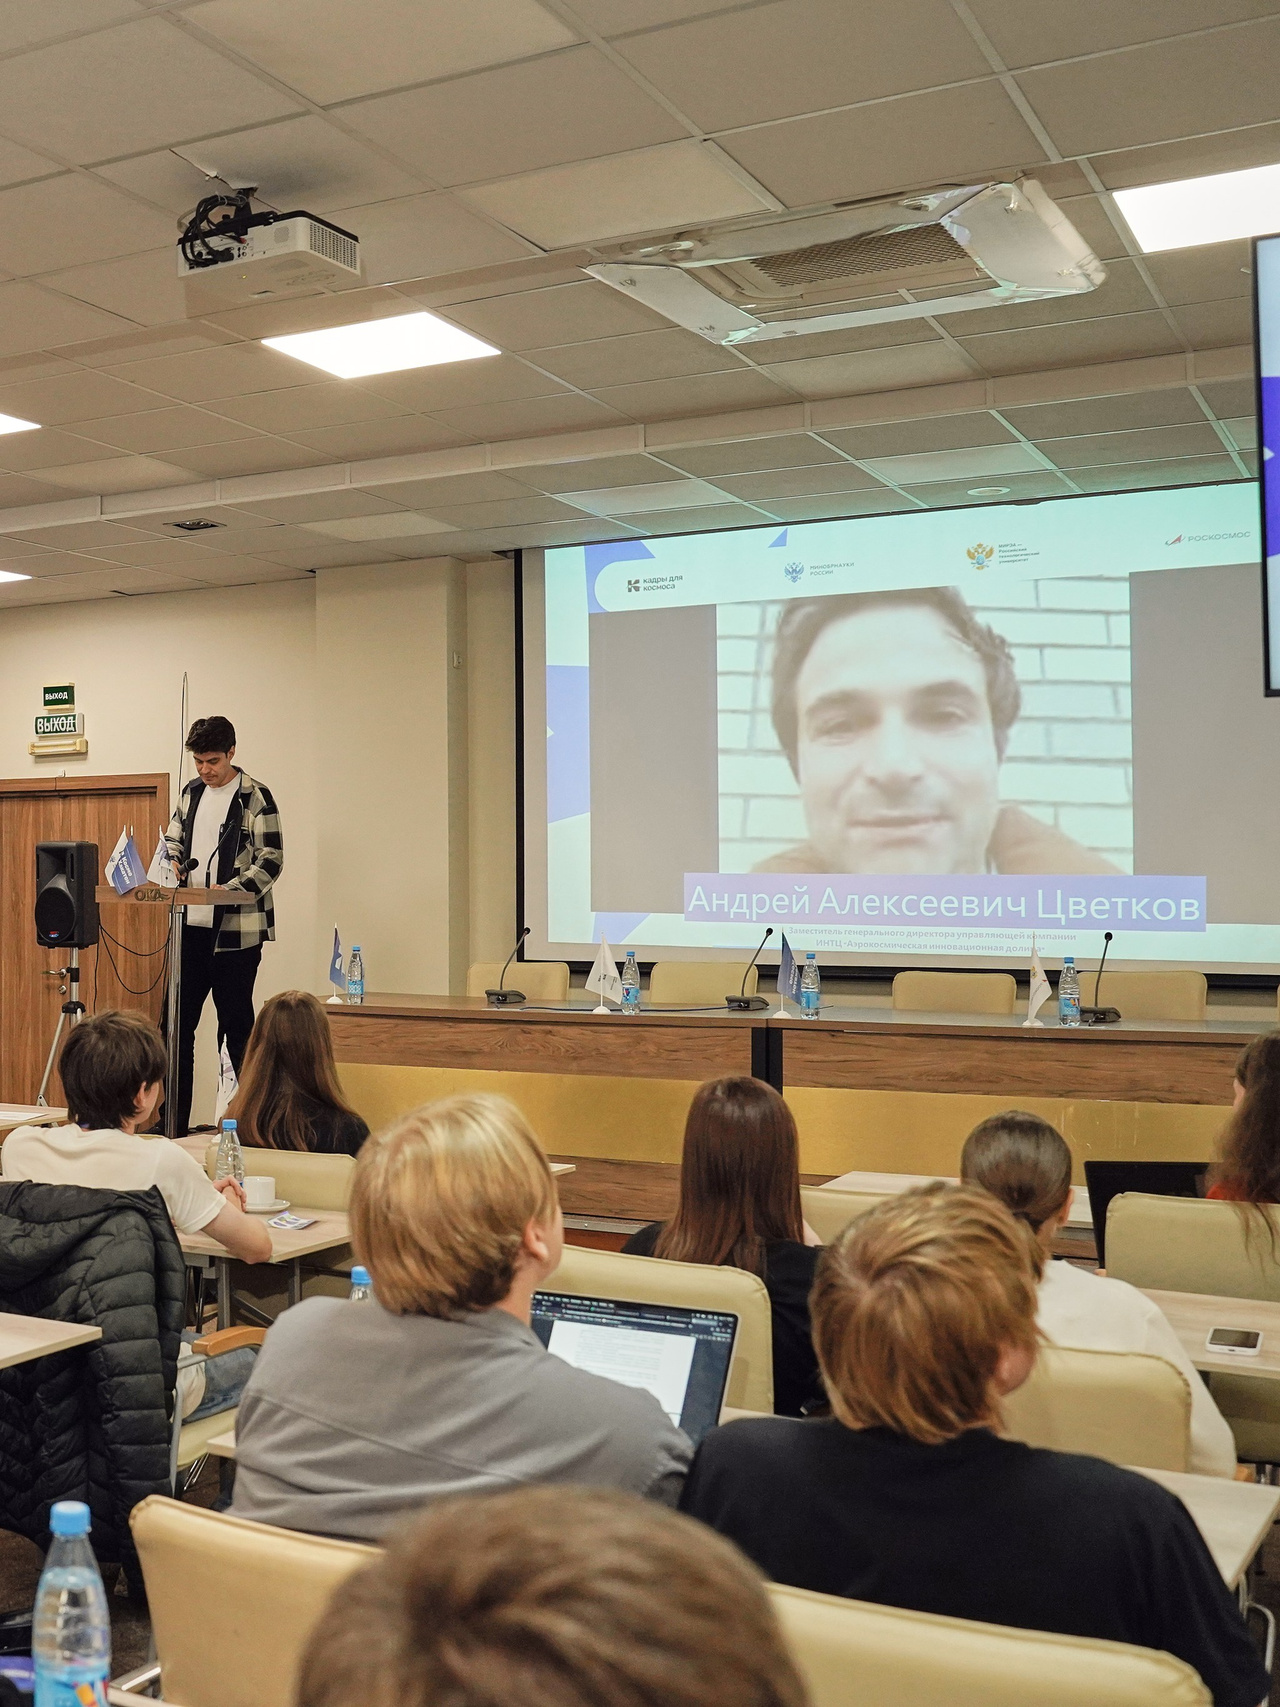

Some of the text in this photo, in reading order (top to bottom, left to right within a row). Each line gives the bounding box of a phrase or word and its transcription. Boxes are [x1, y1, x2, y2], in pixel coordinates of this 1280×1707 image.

[1188, 531, 1251, 542] РОСКОСМОС
[809, 562, 855, 570] МИНОБРНАУКИ
[809, 569, 834, 577] РОССИИ
[643, 575, 683, 584] кадры для
[643, 583, 676, 591] космоса
[45, 691, 68, 701] ВЫХОД
[37, 716, 75, 734] ВЫХОД
[687, 885, 1200, 925] Андрей Алексеевич Цветков
[788, 926, 1077, 942] Заместитель генерального директора управляющей компании
[816, 939, 843, 948] ИНТЦ
[929, 943, 1004, 952] инновационная
